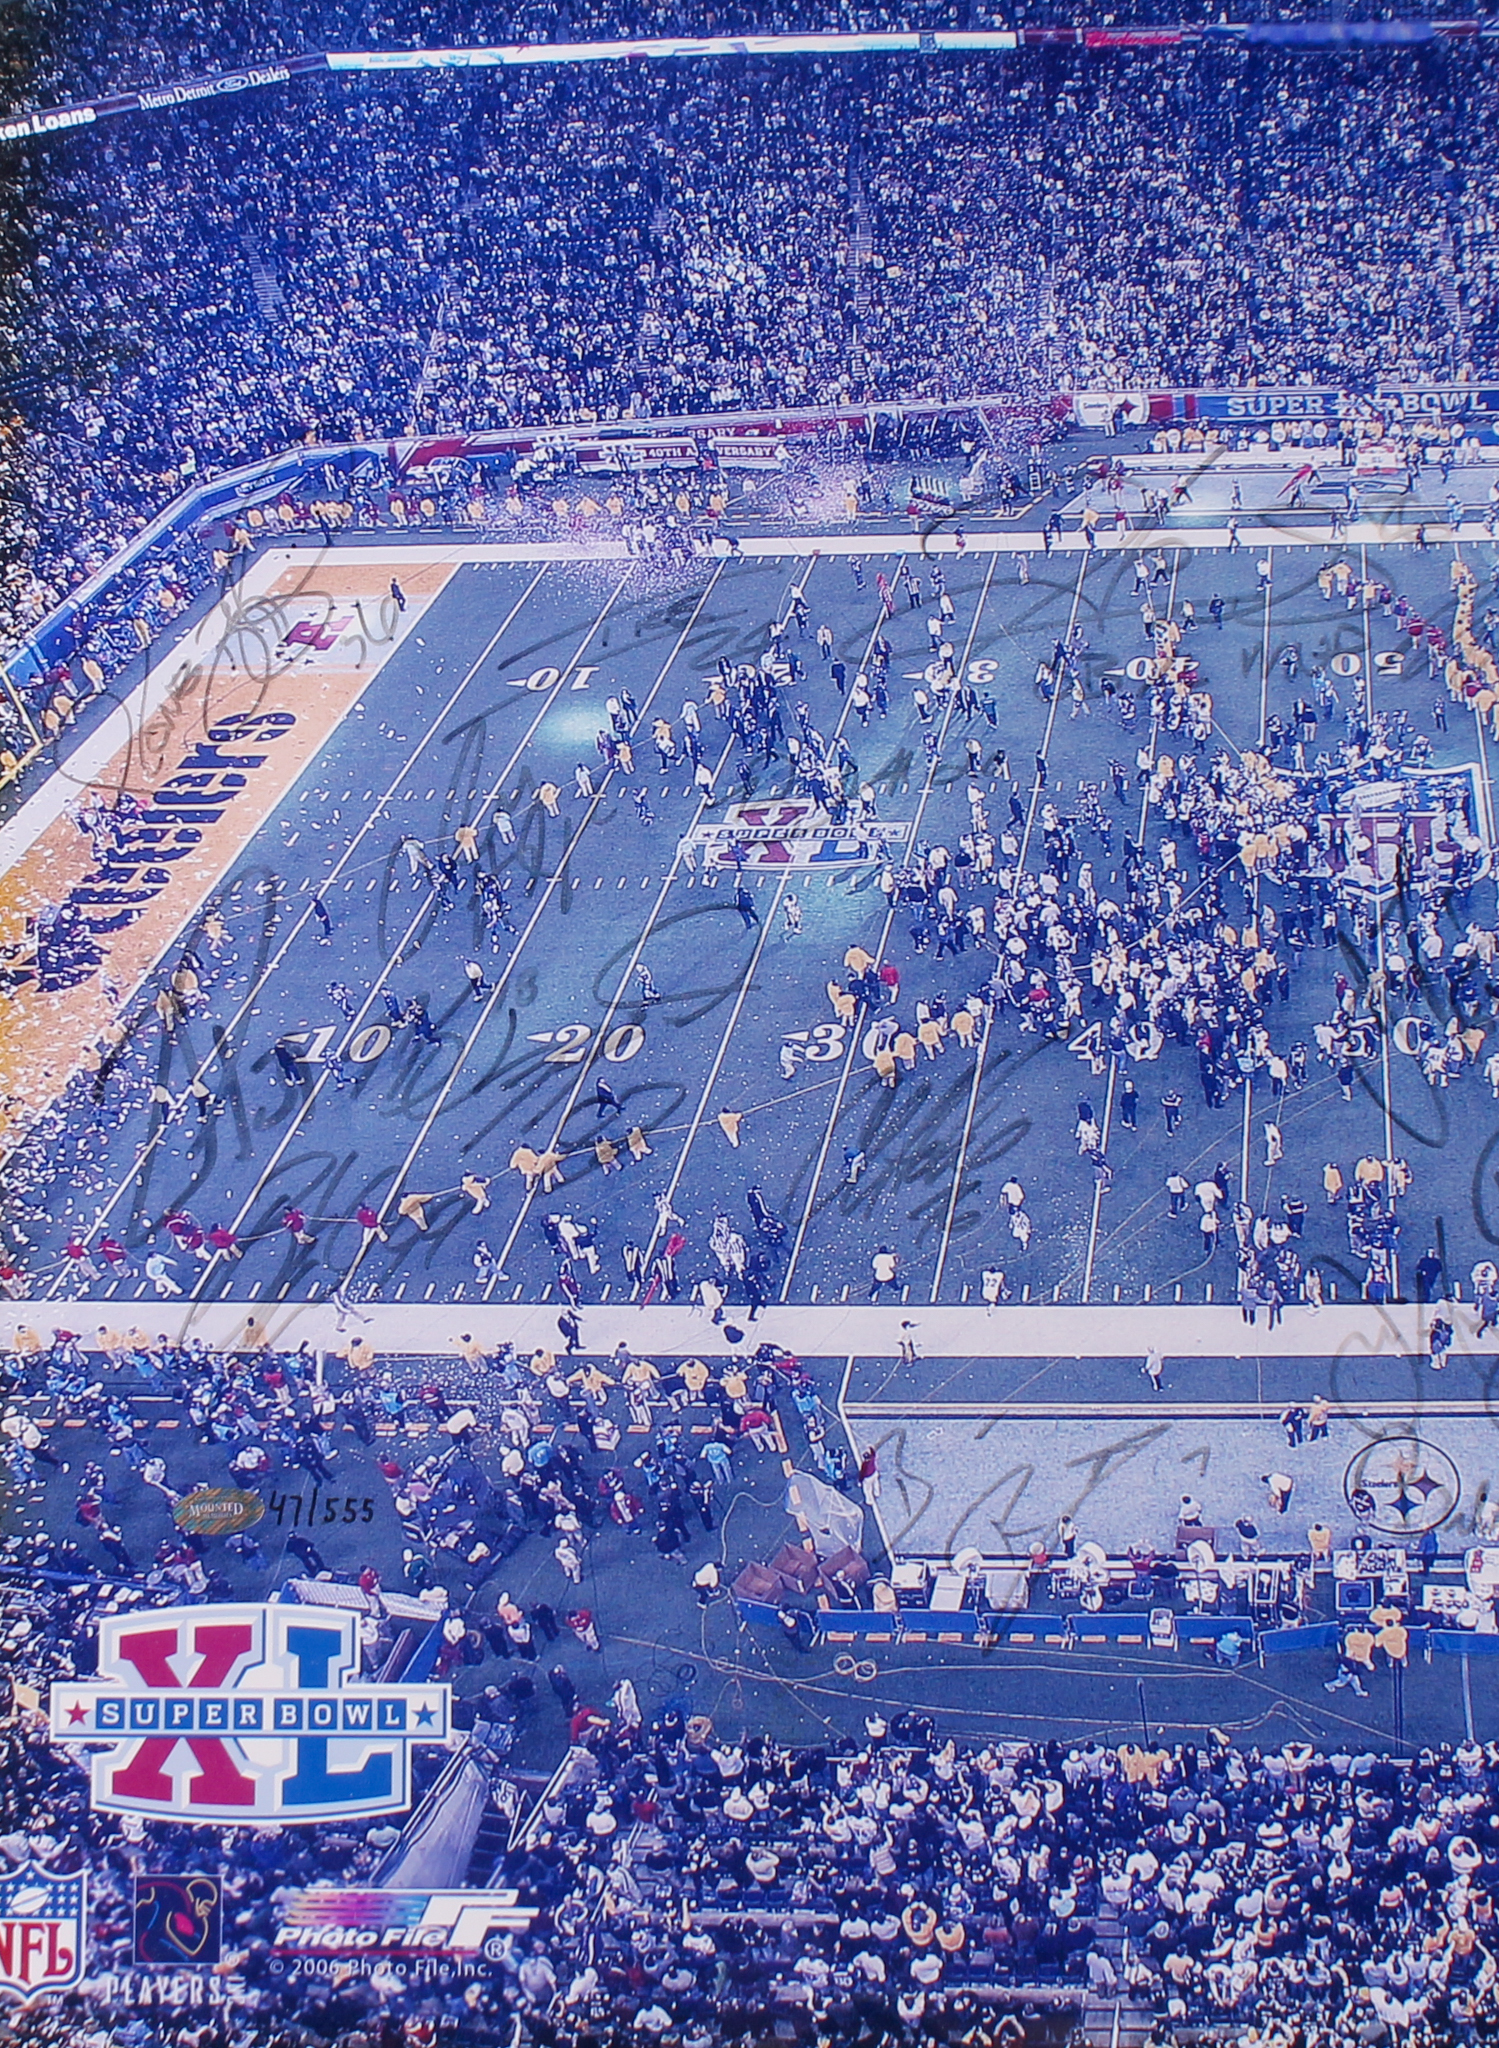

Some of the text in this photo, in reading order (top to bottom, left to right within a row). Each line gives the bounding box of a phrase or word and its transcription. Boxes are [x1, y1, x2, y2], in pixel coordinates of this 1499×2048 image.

[138, 93, 175, 110] Metro
[174, 81, 216, 101] Detroit
[248, 66, 291, 86] Dealers
[32, 107, 97, 133] Loans
[1227, 395, 1325, 417] SUPER
[1401, 391, 1488, 414] BOWL
[1330, 651, 1404, 677] 50
[294, 1023, 392, 1063] 10
[543, 1023, 646, 1063] 20
[189, 1502, 244, 1517] MOUNTED
[268, 1487, 374, 1528] 47/555
